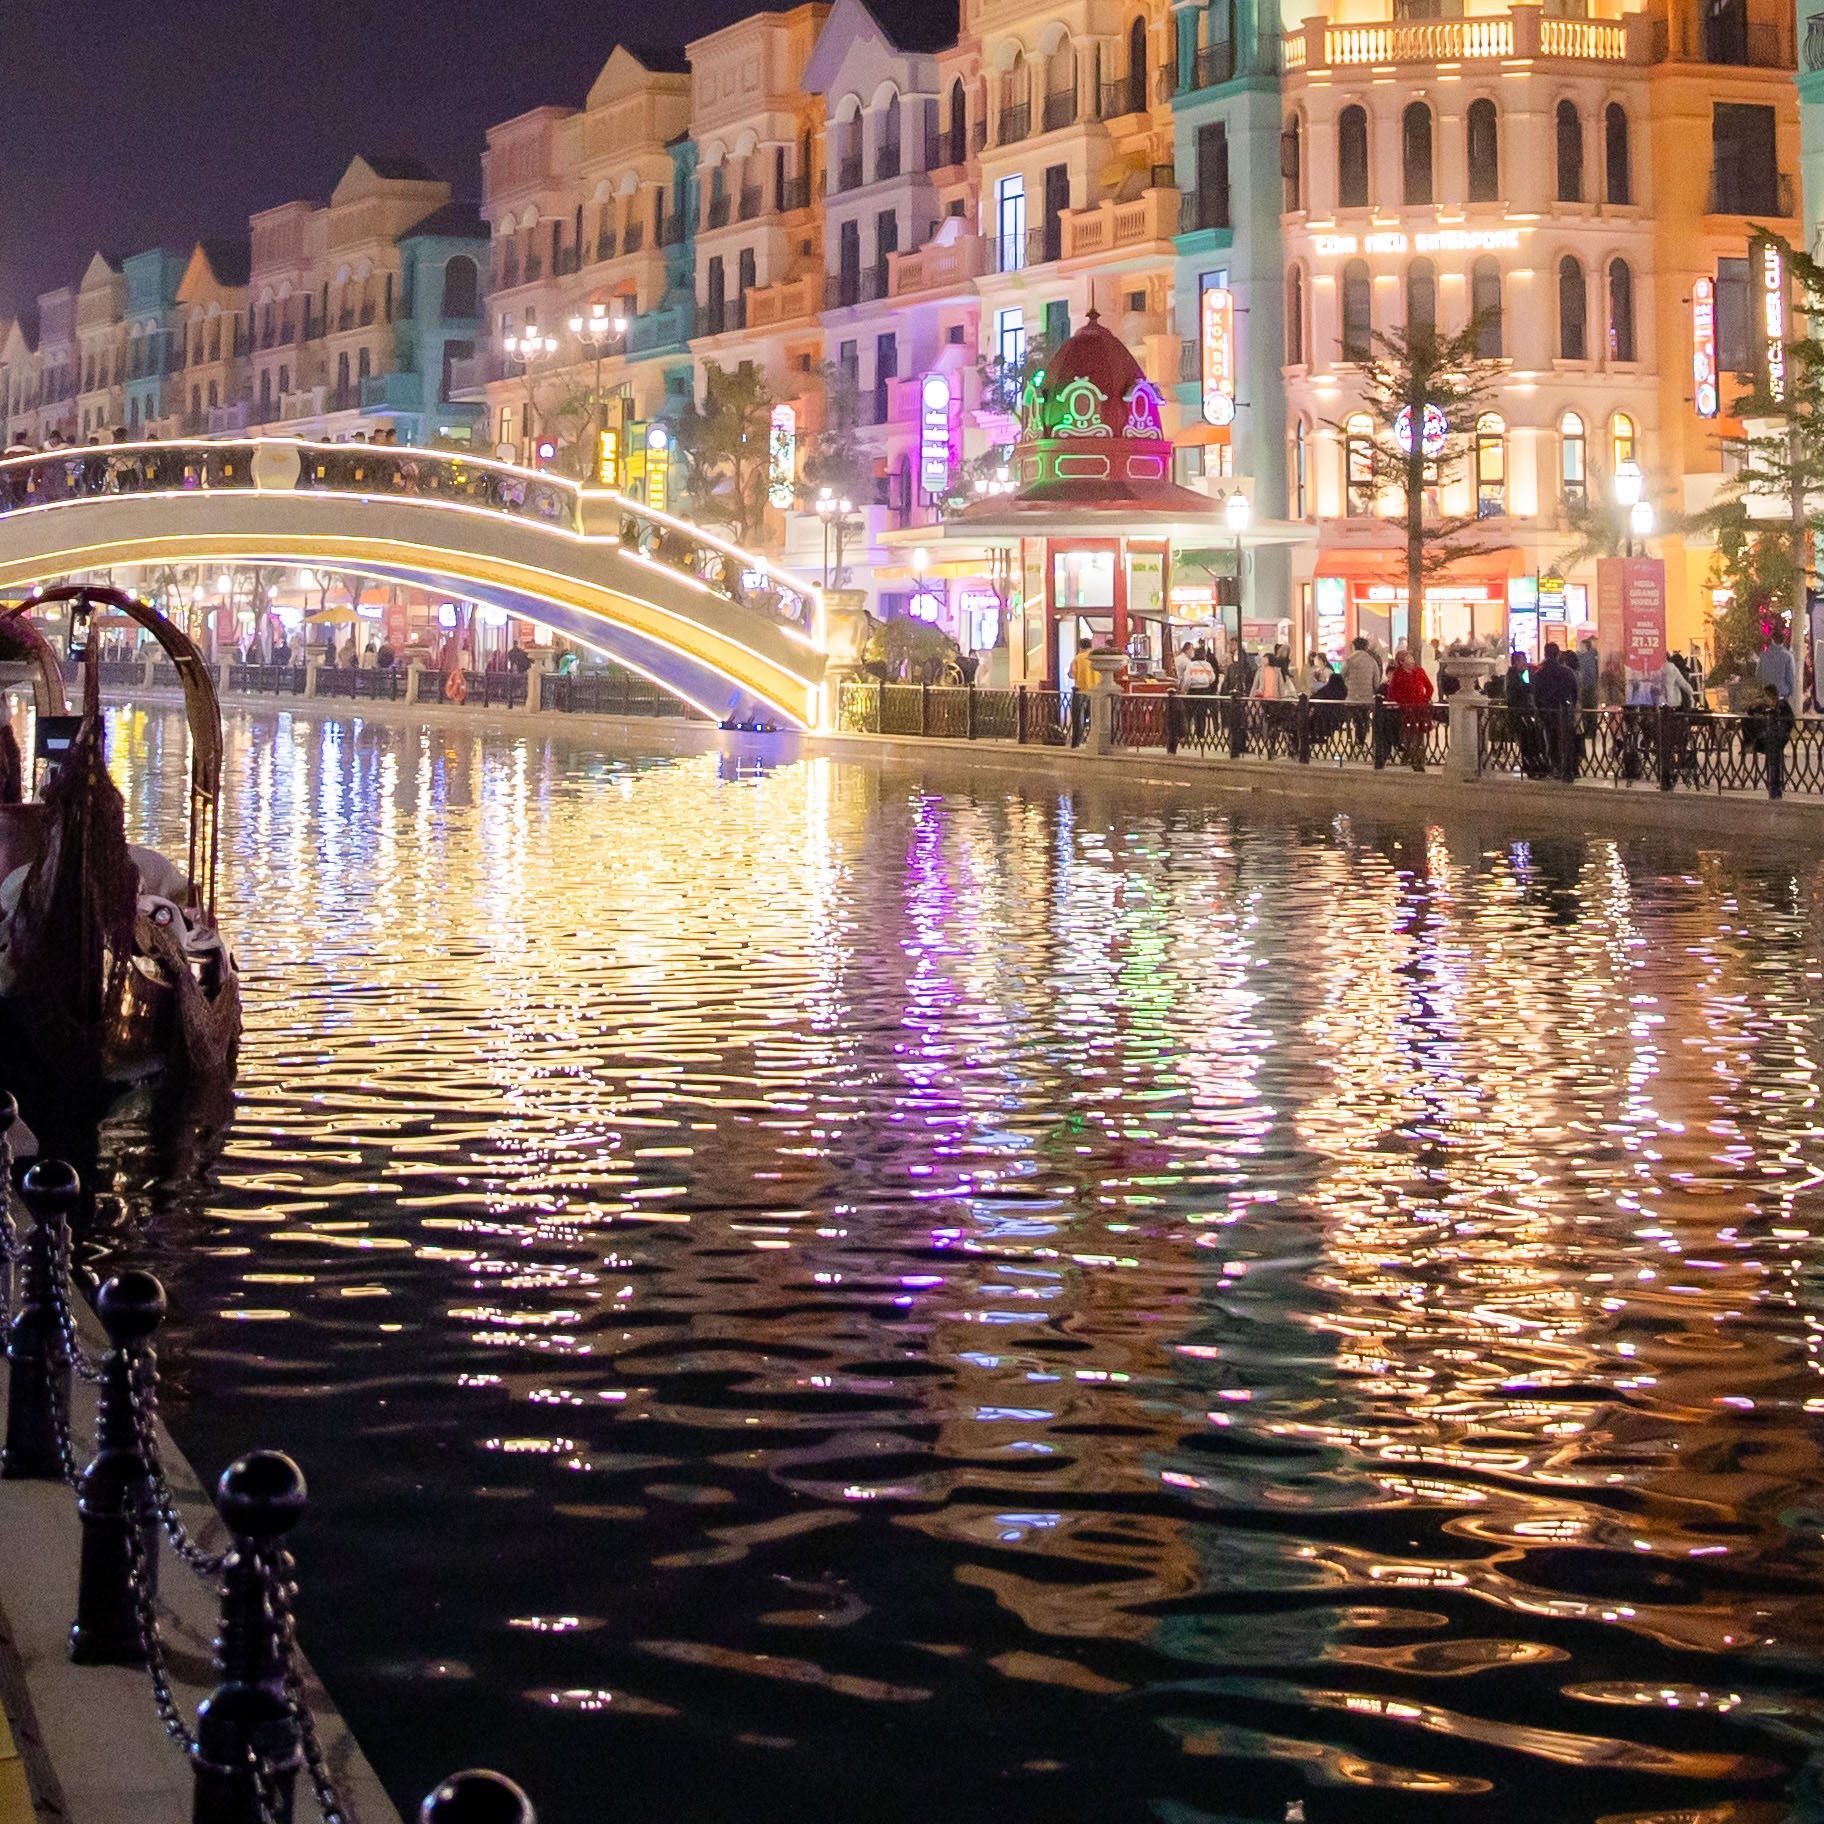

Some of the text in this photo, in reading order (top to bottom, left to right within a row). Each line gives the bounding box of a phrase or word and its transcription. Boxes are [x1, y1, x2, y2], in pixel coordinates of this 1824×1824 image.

[1766, 291, 1782, 337] BEER
[1630, 597, 1660, 606] WORLD
[1632, 637, 1659, 647] 21.12
